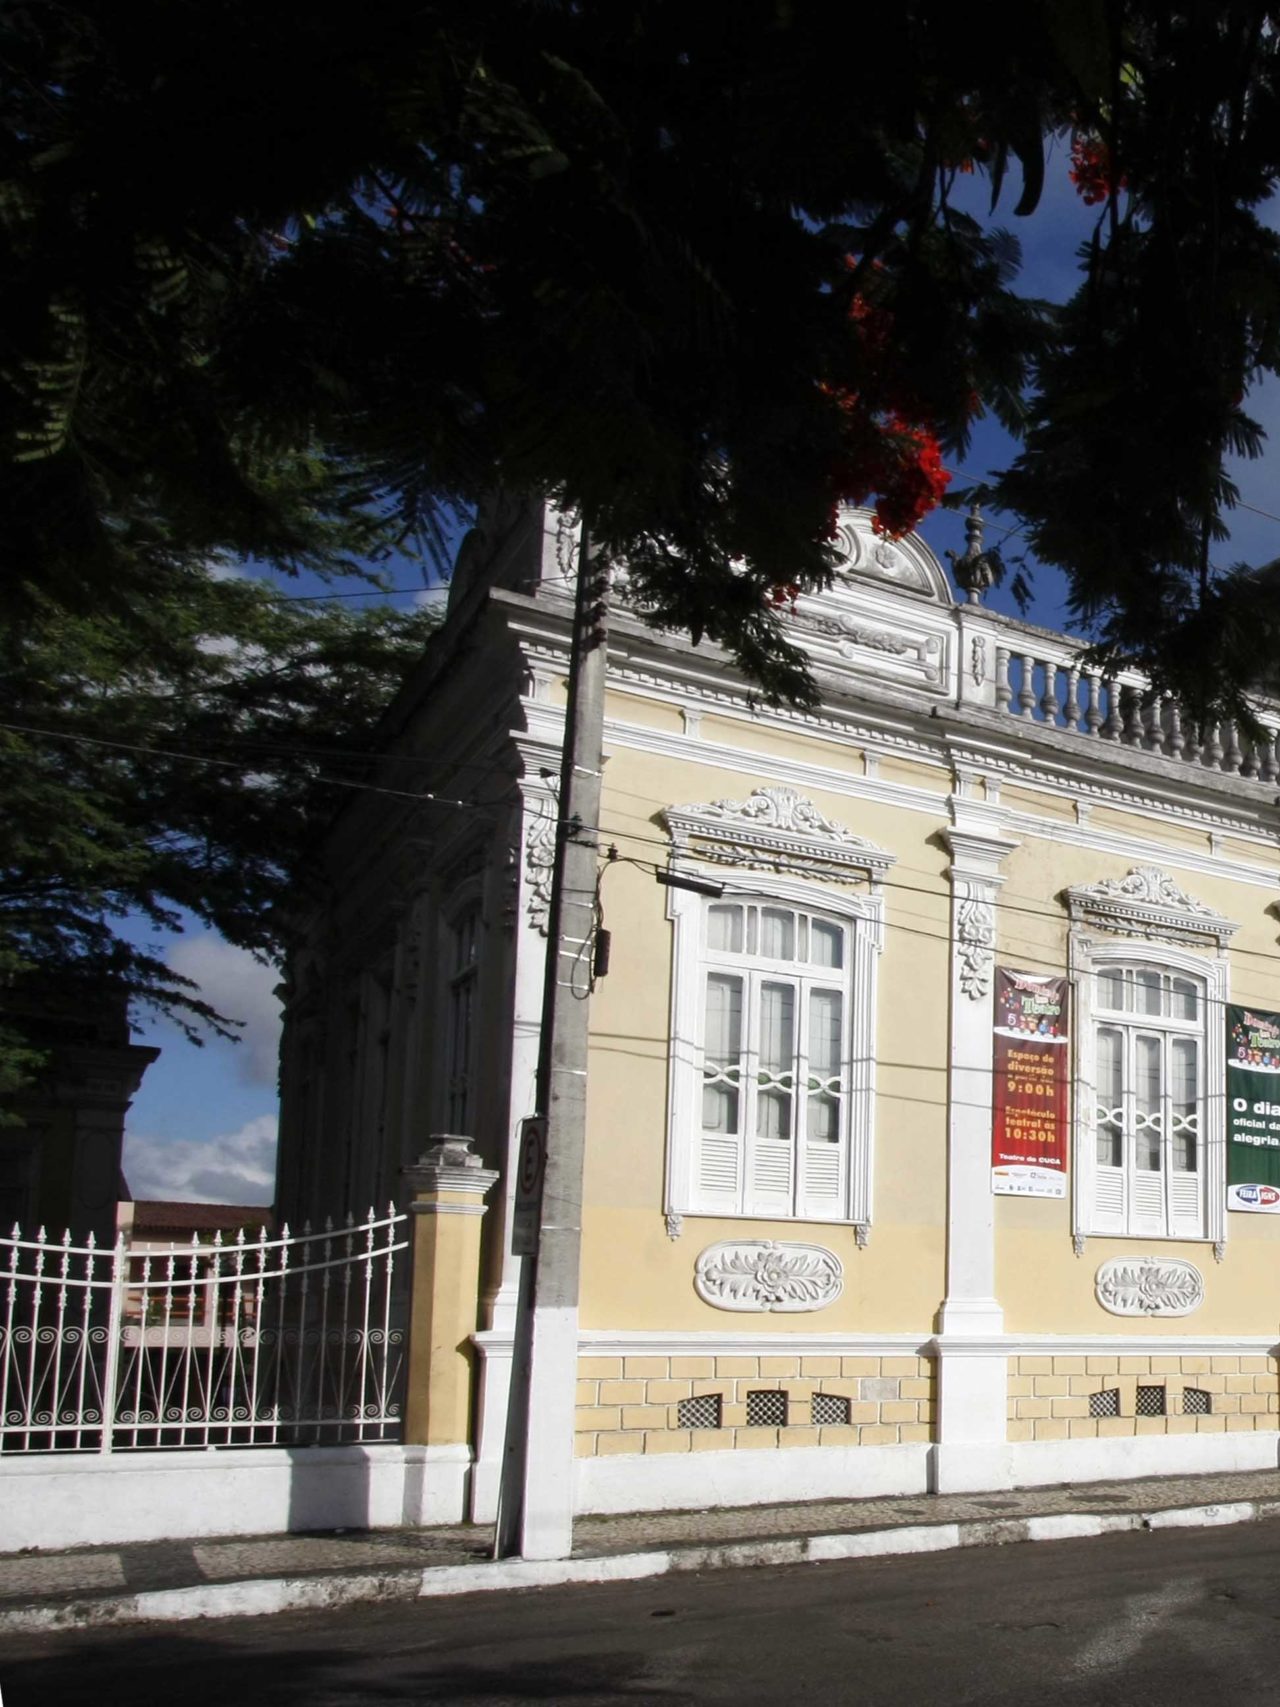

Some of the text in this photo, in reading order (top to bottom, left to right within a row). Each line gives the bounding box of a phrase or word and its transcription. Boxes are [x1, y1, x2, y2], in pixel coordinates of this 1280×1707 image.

[1007, 1049, 1055, 1063] Espaço de
[1007, 1061, 1055, 1076] diversão
[1232, 1097, 1248, 1112] O
[1005, 1117, 1041, 1128] teatral
[1232, 1117, 1266, 1129] oficial
[1005, 1127, 1056, 1143] 10:30h
[998, 1153, 1025, 1163] Teatro
[1038, 1156, 1062, 1165] CUCA
